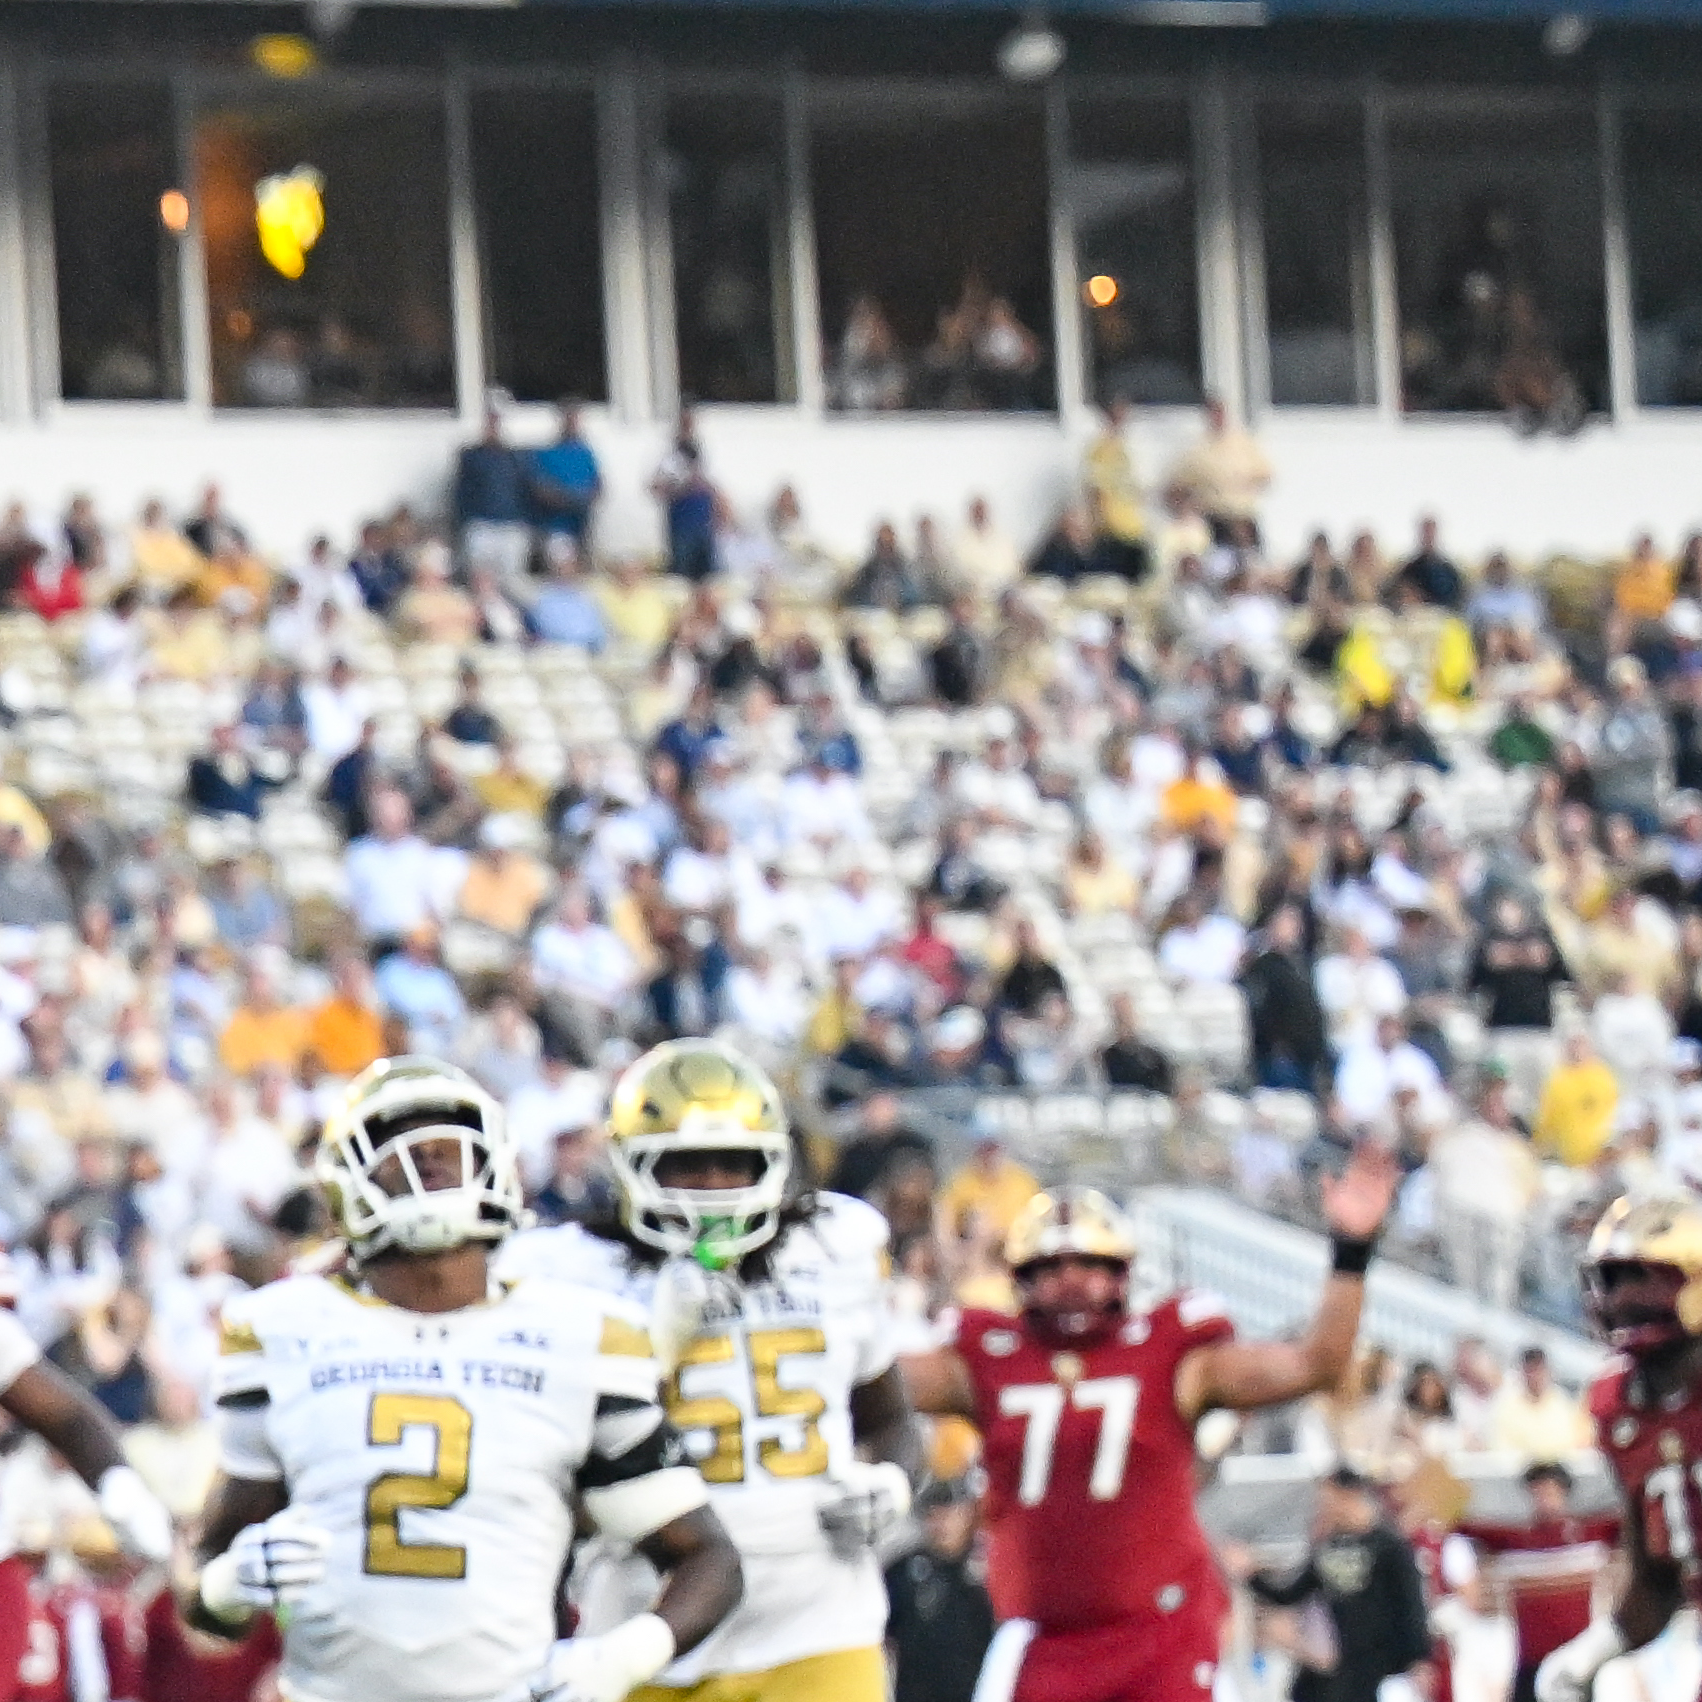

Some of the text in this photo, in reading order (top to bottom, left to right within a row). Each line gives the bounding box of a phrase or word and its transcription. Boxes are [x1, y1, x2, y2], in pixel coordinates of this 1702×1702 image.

[657, 1327, 829, 1484] 55
[998, 1374, 1143, 1509] 77
[361, 1391, 474, 1580] 2
